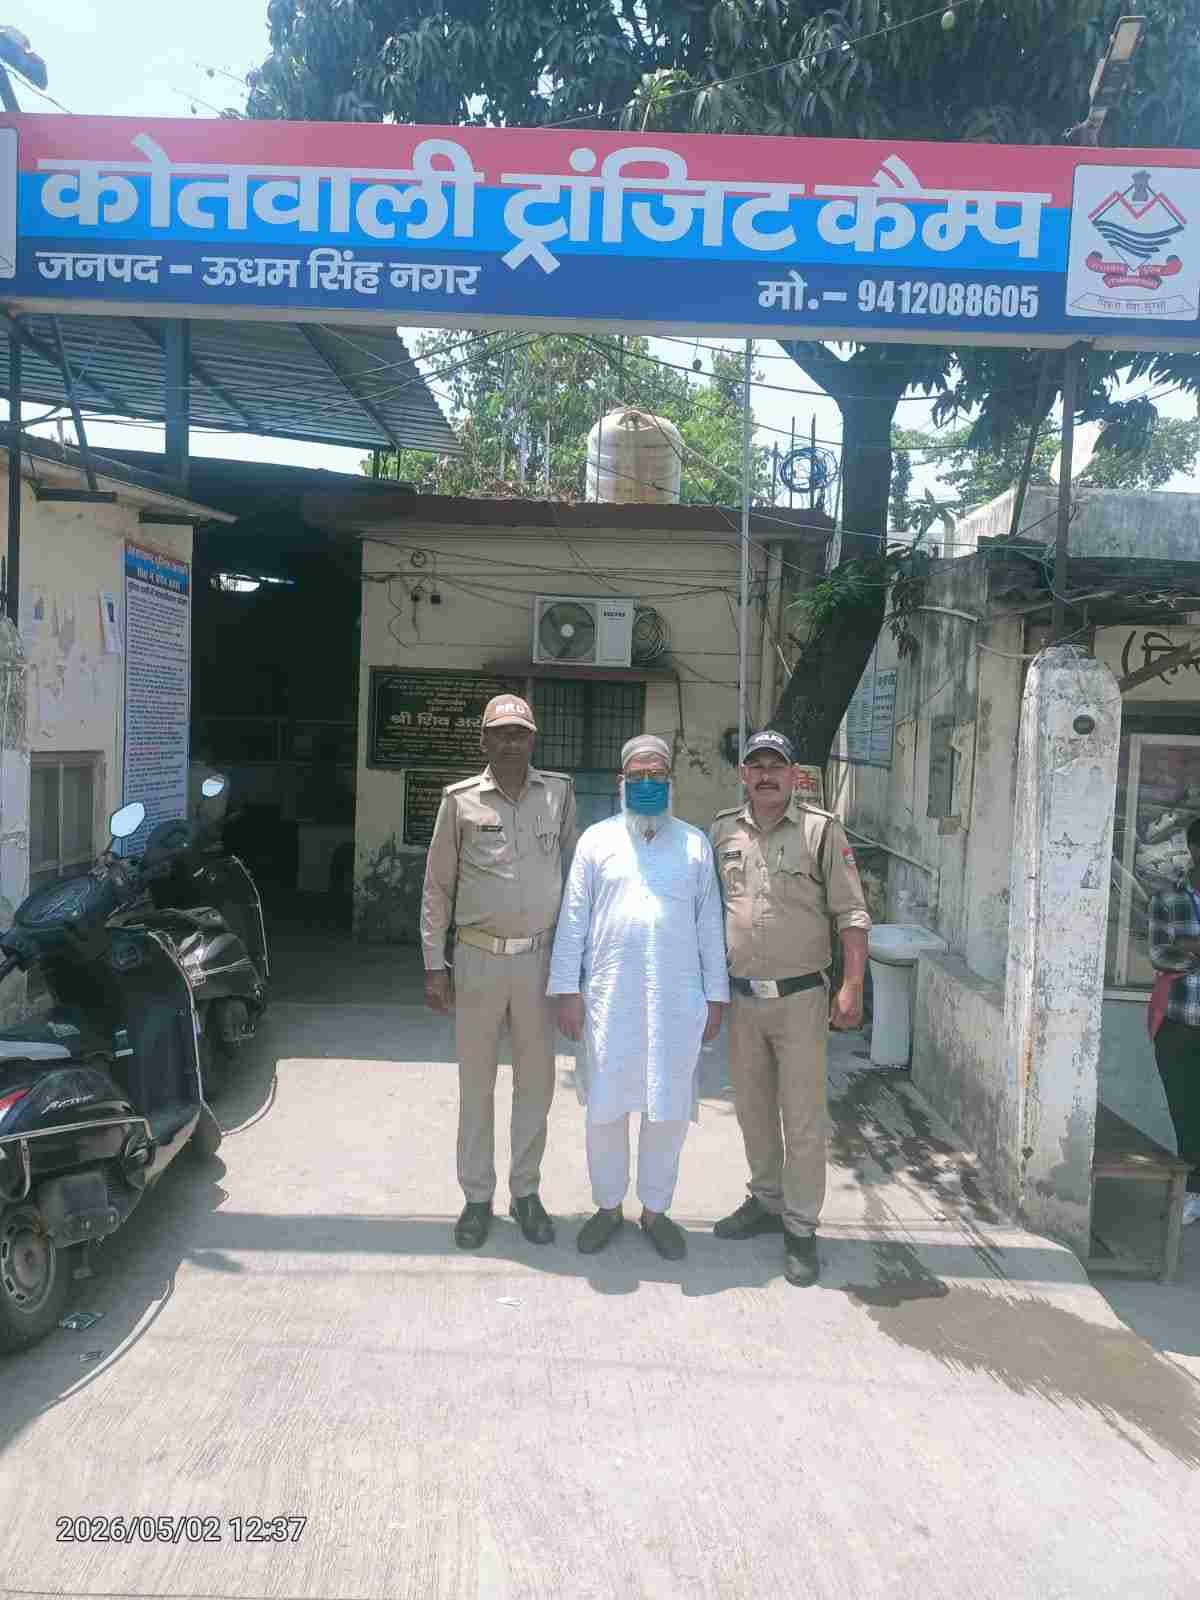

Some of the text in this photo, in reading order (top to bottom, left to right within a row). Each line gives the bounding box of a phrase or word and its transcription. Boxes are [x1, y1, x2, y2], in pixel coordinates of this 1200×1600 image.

[37, 133, 1053, 274] कोतवाली ट्रांजिट कैम्प
[35, 251, 162, 283] जनपद
[201, 255, 301, 288] ऊधम
[307, 247, 383, 294] सिंह
[389, 262, 482, 295] नगर
[857, 280, 1039, 319] 9412088605
